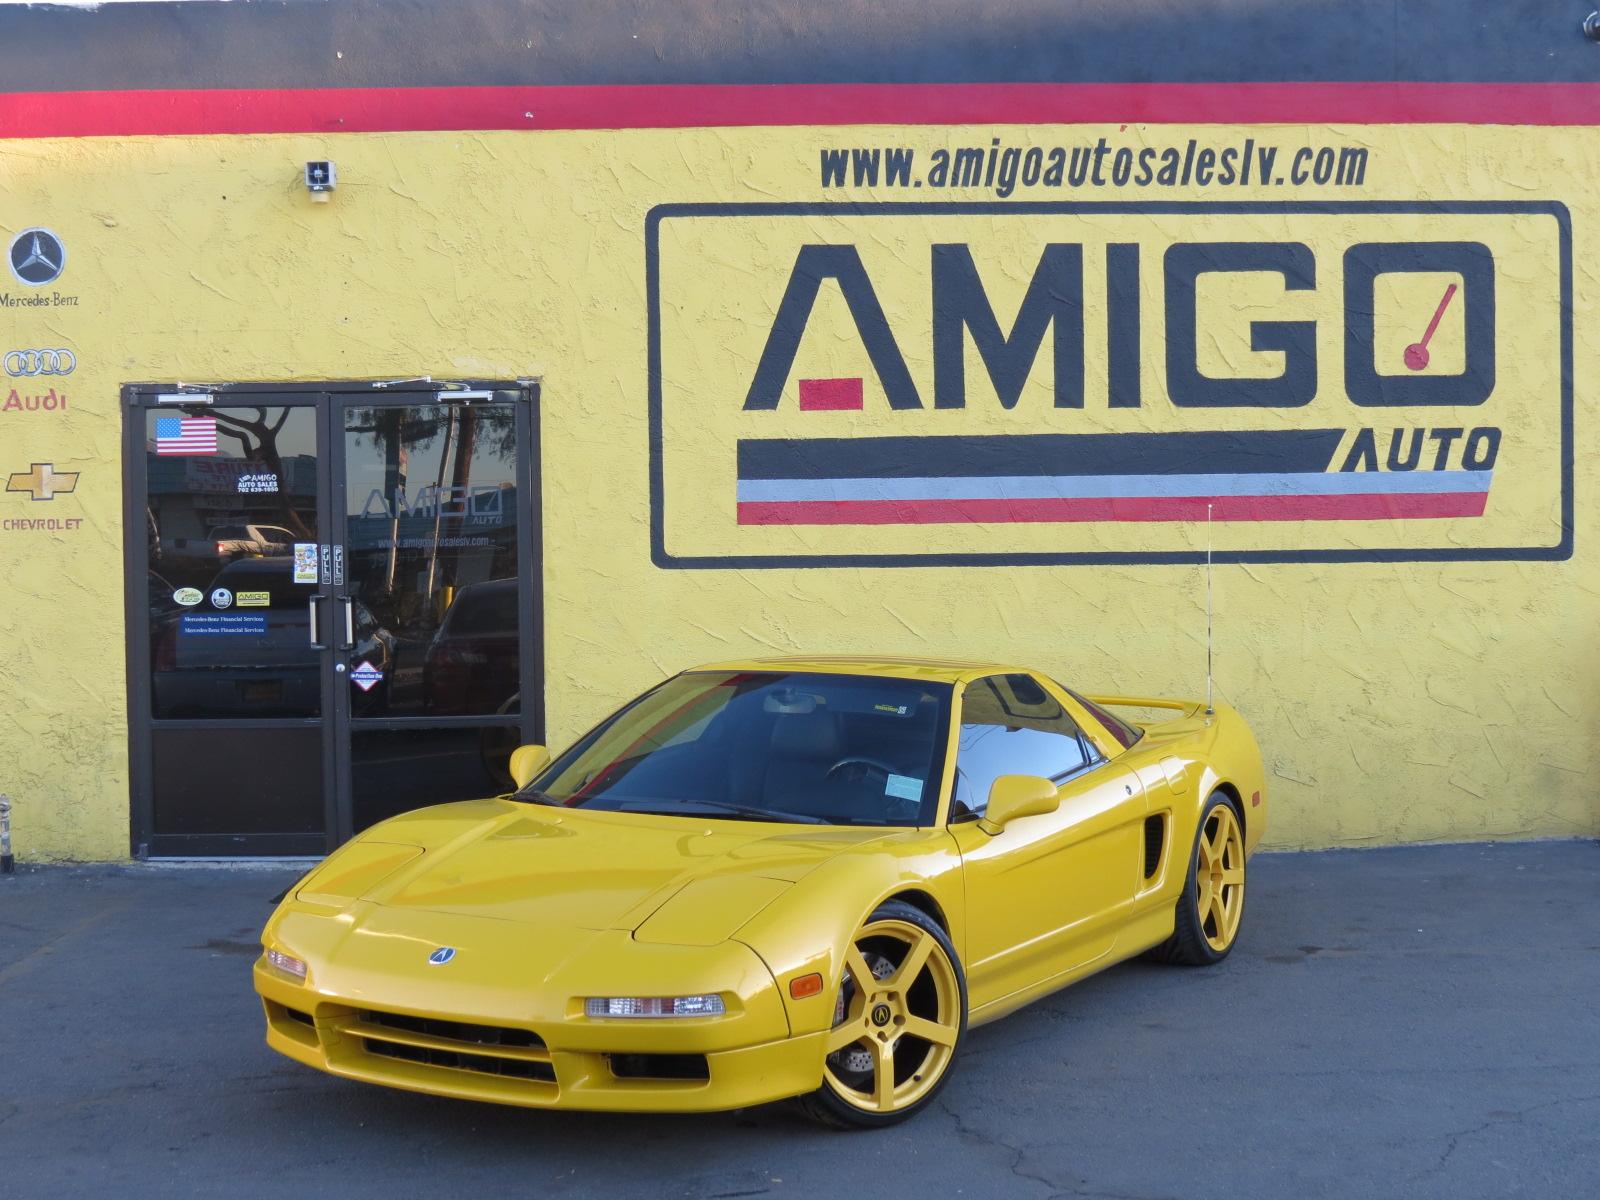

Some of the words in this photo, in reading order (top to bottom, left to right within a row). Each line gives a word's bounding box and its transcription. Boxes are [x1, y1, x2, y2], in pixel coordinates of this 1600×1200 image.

[820, 138, 1369, 198] www.amigoautosaleslv.com
[0, 291, 79, 307] Mercedes-Benz
[742, 241, 1496, 410] AMIGO
[2, 388, 66, 411] Audi
[1338, 426, 1502, 472] AUTO
[251, 474, 277, 482] AMIGO
[360, 486, 503, 518] AMIGO
[3, 519, 83, 531] CHEVROLET
[471, 516, 503, 525] AUTO
